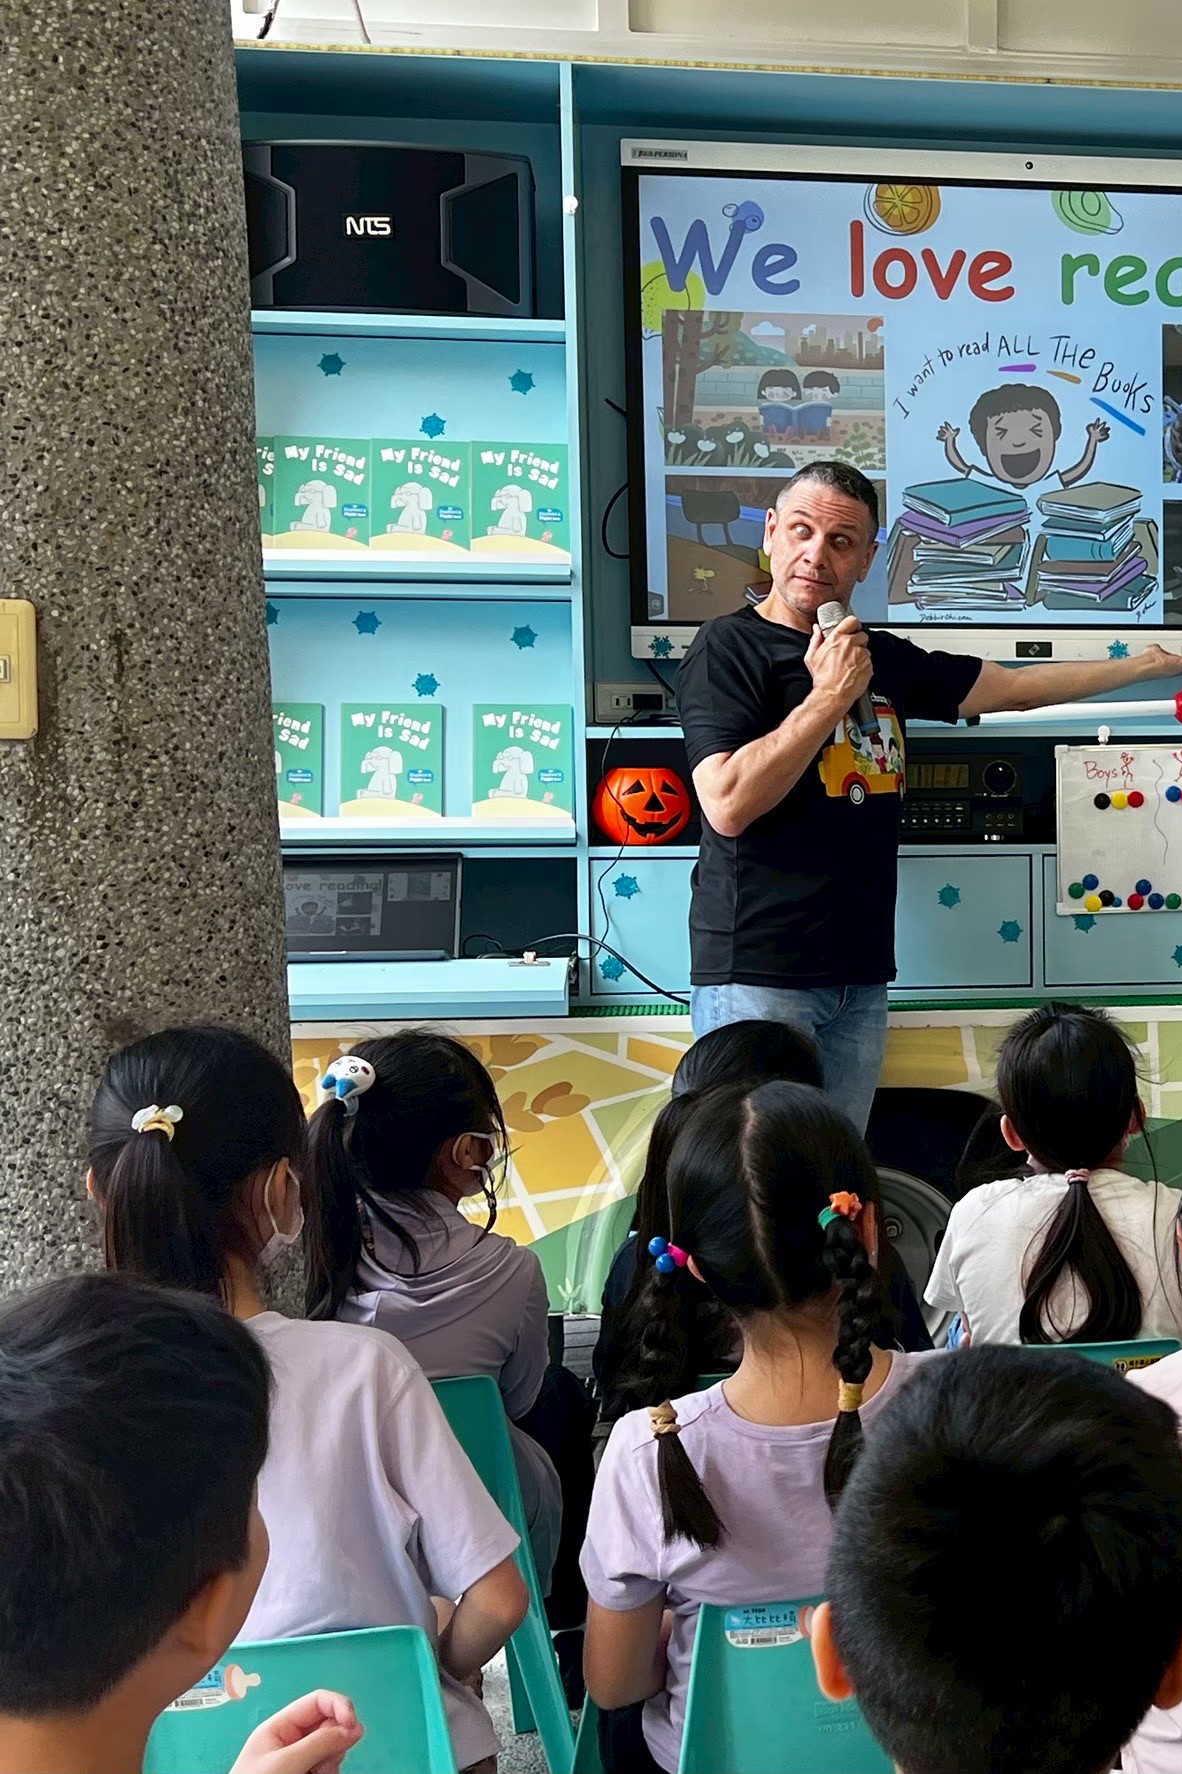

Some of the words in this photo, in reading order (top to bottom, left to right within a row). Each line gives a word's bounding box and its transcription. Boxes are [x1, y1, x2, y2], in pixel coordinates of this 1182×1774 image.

[346, 216, 391, 235] NTS
[650, 216, 801, 296] We
[849, 219, 1015, 303] love
[893, 396, 911, 420] I
[907, 354, 936, 398] want
[937, 347, 954, 368] to
[957, 331, 990, 358] read
[997, 334, 1040, 358] ALL
[284, 445, 310, 461] My
[315, 444, 366, 470] Friend
[380, 448, 405, 463] My
[411, 447, 461, 472] Friend
[480, 450, 505, 466] My
[510, 449, 560, 474] Friend
[311, 458, 327, 472] Is
[333, 463, 365, 486] Sad
[407, 461, 423, 474] Is
[429, 466, 460, 488] Sad
[507, 463, 523, 477] Is
[528, 468, 559, 490] Sad
[351, 712, 376, 728] My
[381, 710, 431, 734] Friend
[482, 712, 507, 728] My
[512, 711, 561, 735] Friend
[278, 728, 310, 750] Sad
[378, 725, 393, 738] Is
[399, 728, 430, 751] Sad
[509, 725, 524, 739] Is
[529, 729, 560, 750] Sad
[1083, 760, 1118, 789] Boys
